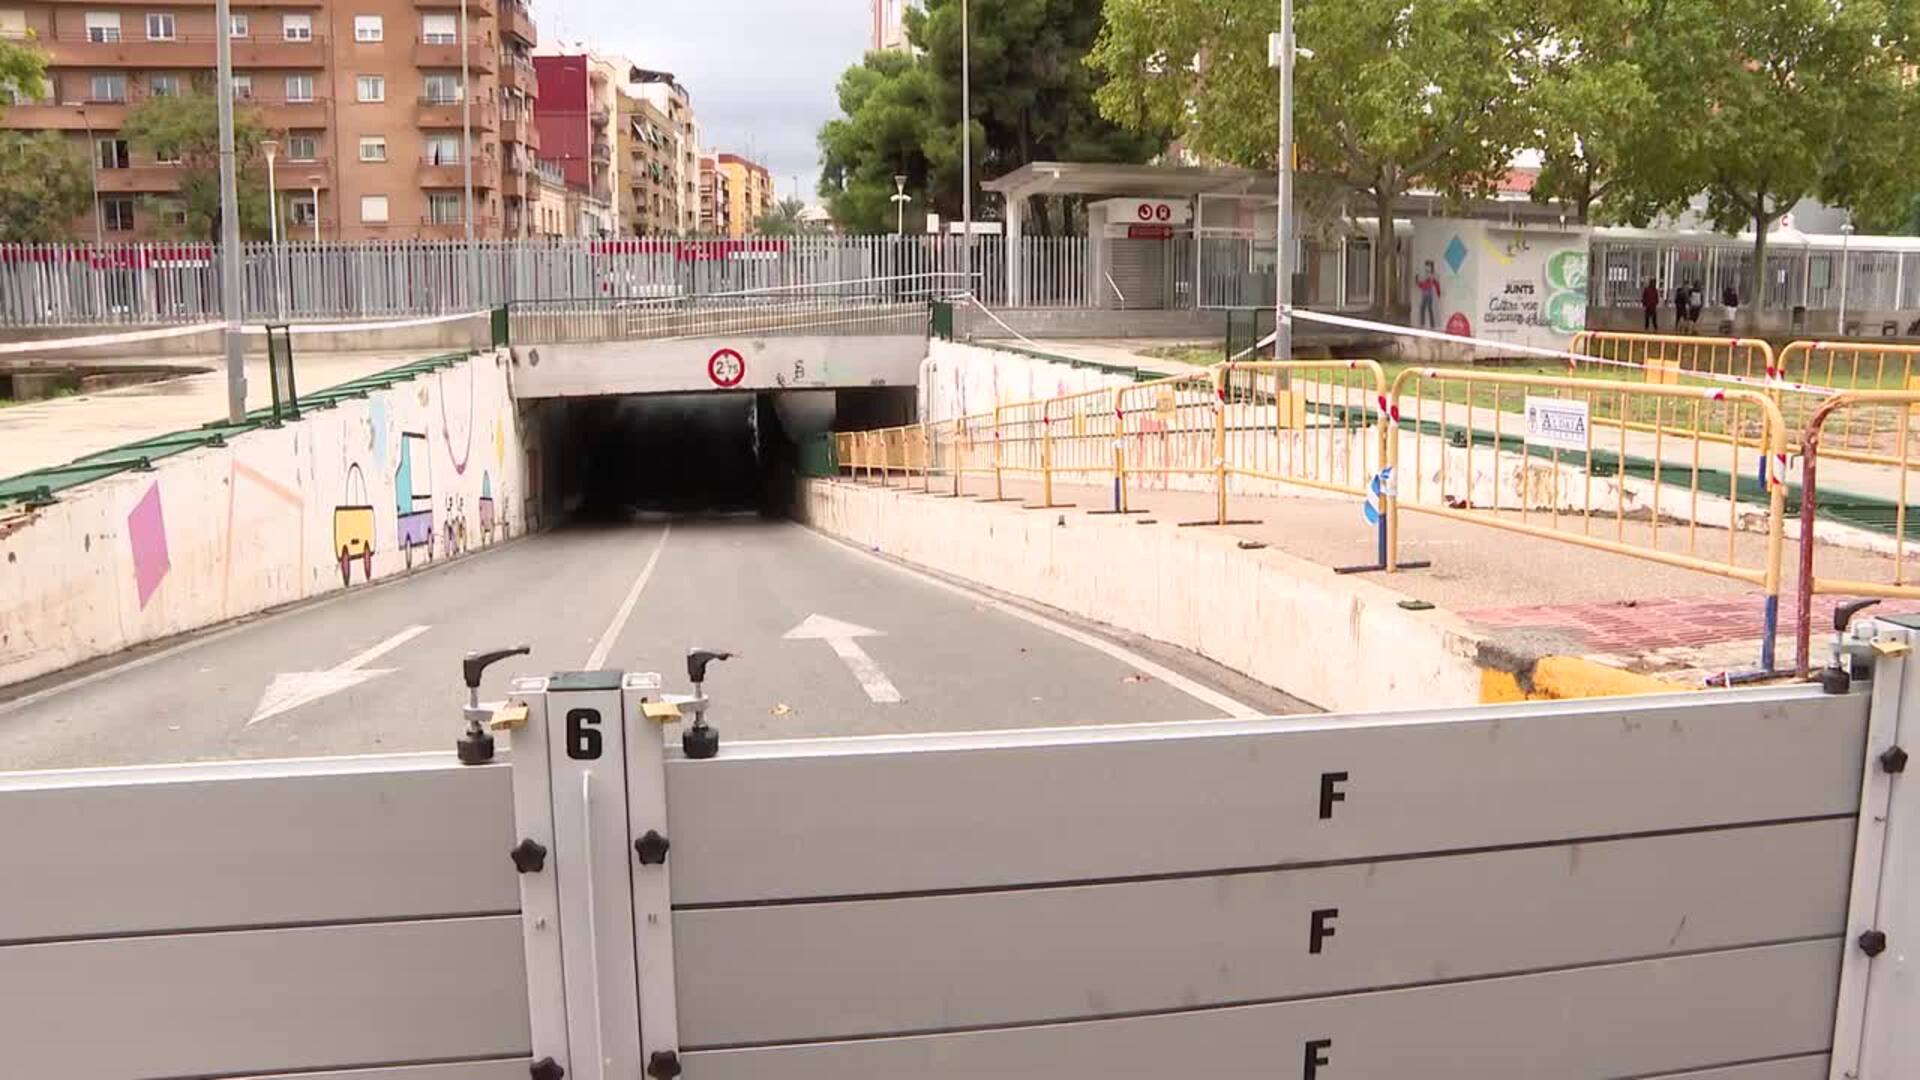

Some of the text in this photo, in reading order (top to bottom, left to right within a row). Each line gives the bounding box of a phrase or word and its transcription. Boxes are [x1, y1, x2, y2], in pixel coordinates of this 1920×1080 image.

[1503, 284, 1535, 295] JUNTS
[566, 708, 602, 760] 6
[1319, 771, 1348, 819] F
[1309, 908, 1339, 954] F
[1303, 1038, 1331, 1080] F
